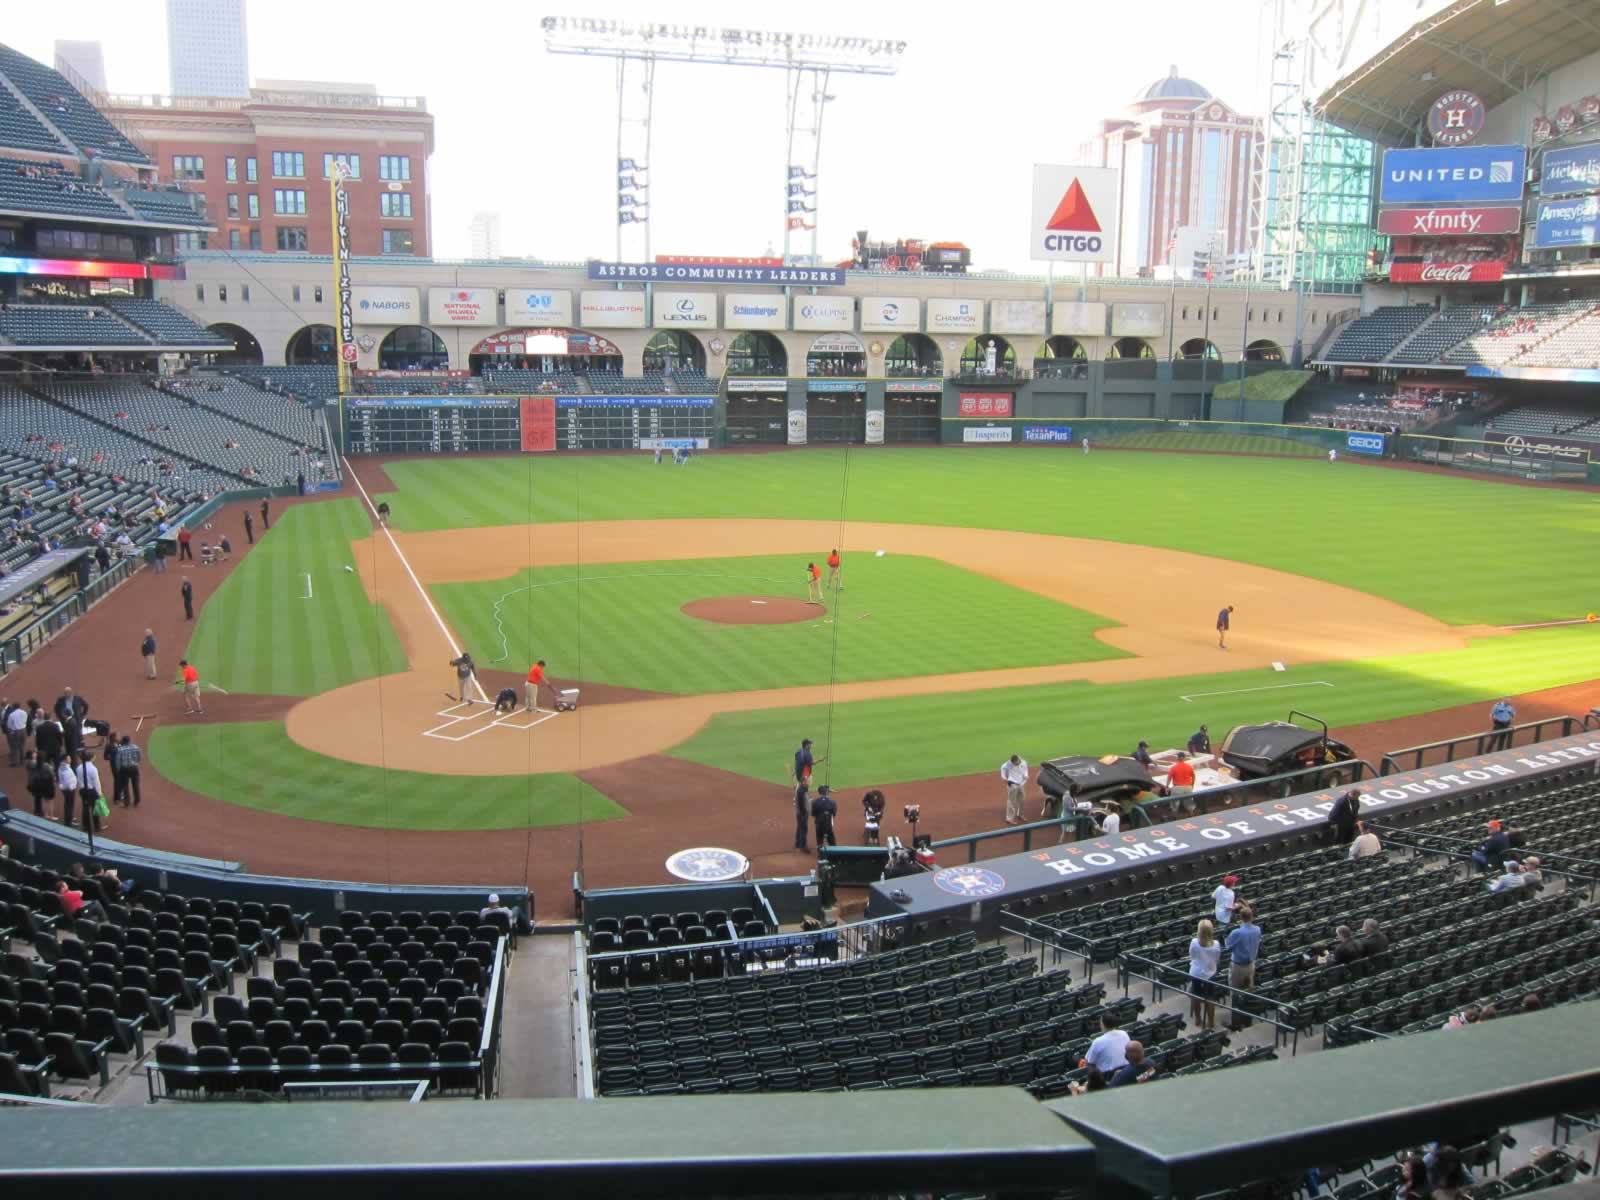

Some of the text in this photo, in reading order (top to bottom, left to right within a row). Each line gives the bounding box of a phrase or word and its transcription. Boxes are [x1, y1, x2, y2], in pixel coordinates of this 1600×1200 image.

[1437, 94, 1478, 108] HOUSTON
[1445, 110, 1466, 127] H
[1435, 129, 1473, 142] ASTROS
[1391, 167, 1484, 183] UNITED
[1413, 211, 1483, 233] xfinity
[1044, 235, 1102, 252] CITGO
[336, 189, 353, 341] CHIKIN IZ FARE
[598, 265, 838, 281] ASTROS COMMUNITY LEADERS
[372, 301, 411, 309] NABORS
[733, 306, 778, 317] Schlumberger
[935, 314, 976, 322] CHAMPION
[975, 430, 1010, 440] Insperity
[1026, 430, 1068, 440] TexanPlus
[1348, 437, 1382, 449] GEICO
[1044, 835, 1190, 875] HOME
[1200, 821, 1257, 841] OF
[1358, 764, 1516, 807] HOUSTON
[1032, 817, 1223, 861] WELCOME
[1248, 804, 1289, 816] TO
